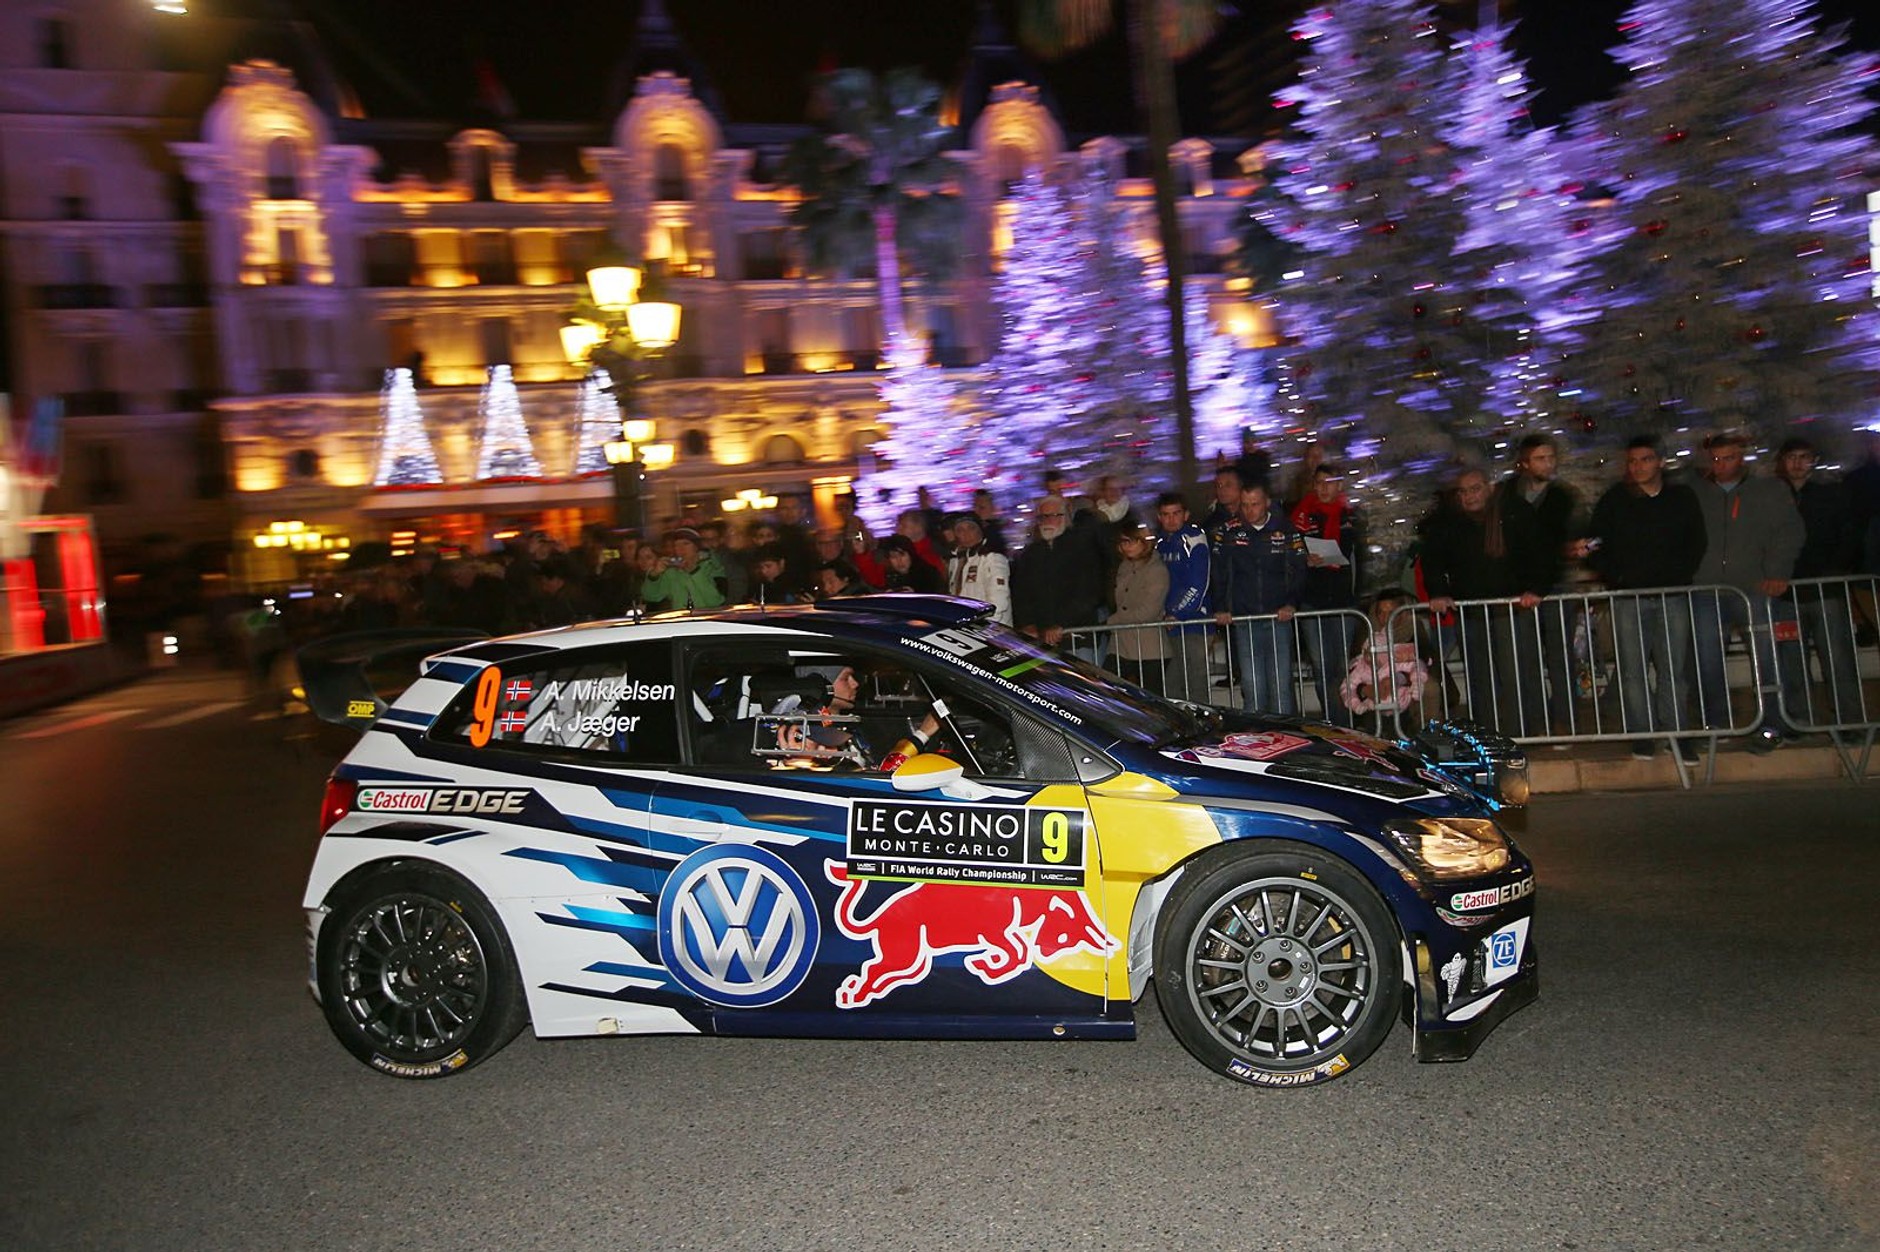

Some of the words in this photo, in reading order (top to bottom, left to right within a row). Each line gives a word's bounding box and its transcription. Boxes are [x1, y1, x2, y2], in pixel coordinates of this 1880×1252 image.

[544, 680, 565, 701] A.
[572, 680, 675, 701] Mikkelsen
[900, 637, 1082, 726] www.volkswagen-motorsport.com
[347, 702, 375, 716] OMP
[469, 665, 502, 748] 9
[540, 711, 562, 732] A.
[567, 711, 640, 738] Jæger
[373, 790, 427, 810] Castrol
[429, 790, 531, 815] EDGE
[856, 808, 887, 833] LE
[893, 809, 1020, 839] CASINO
[1041, 812, 1069, 864] 9
[890, 864, 906, 874] FIA
[907, 865, 935, 876] World
[936, 866, 959, 879] Rally
[962, 868, 1027, 882] Championship
[1463, 890, 1498, 909] Castrol
[1495, 940, 1513, 960] ZF
[374, 1057, 441, 1076] MICHELIN
[1230, 1064, 1316, 1085] MICHELIN
